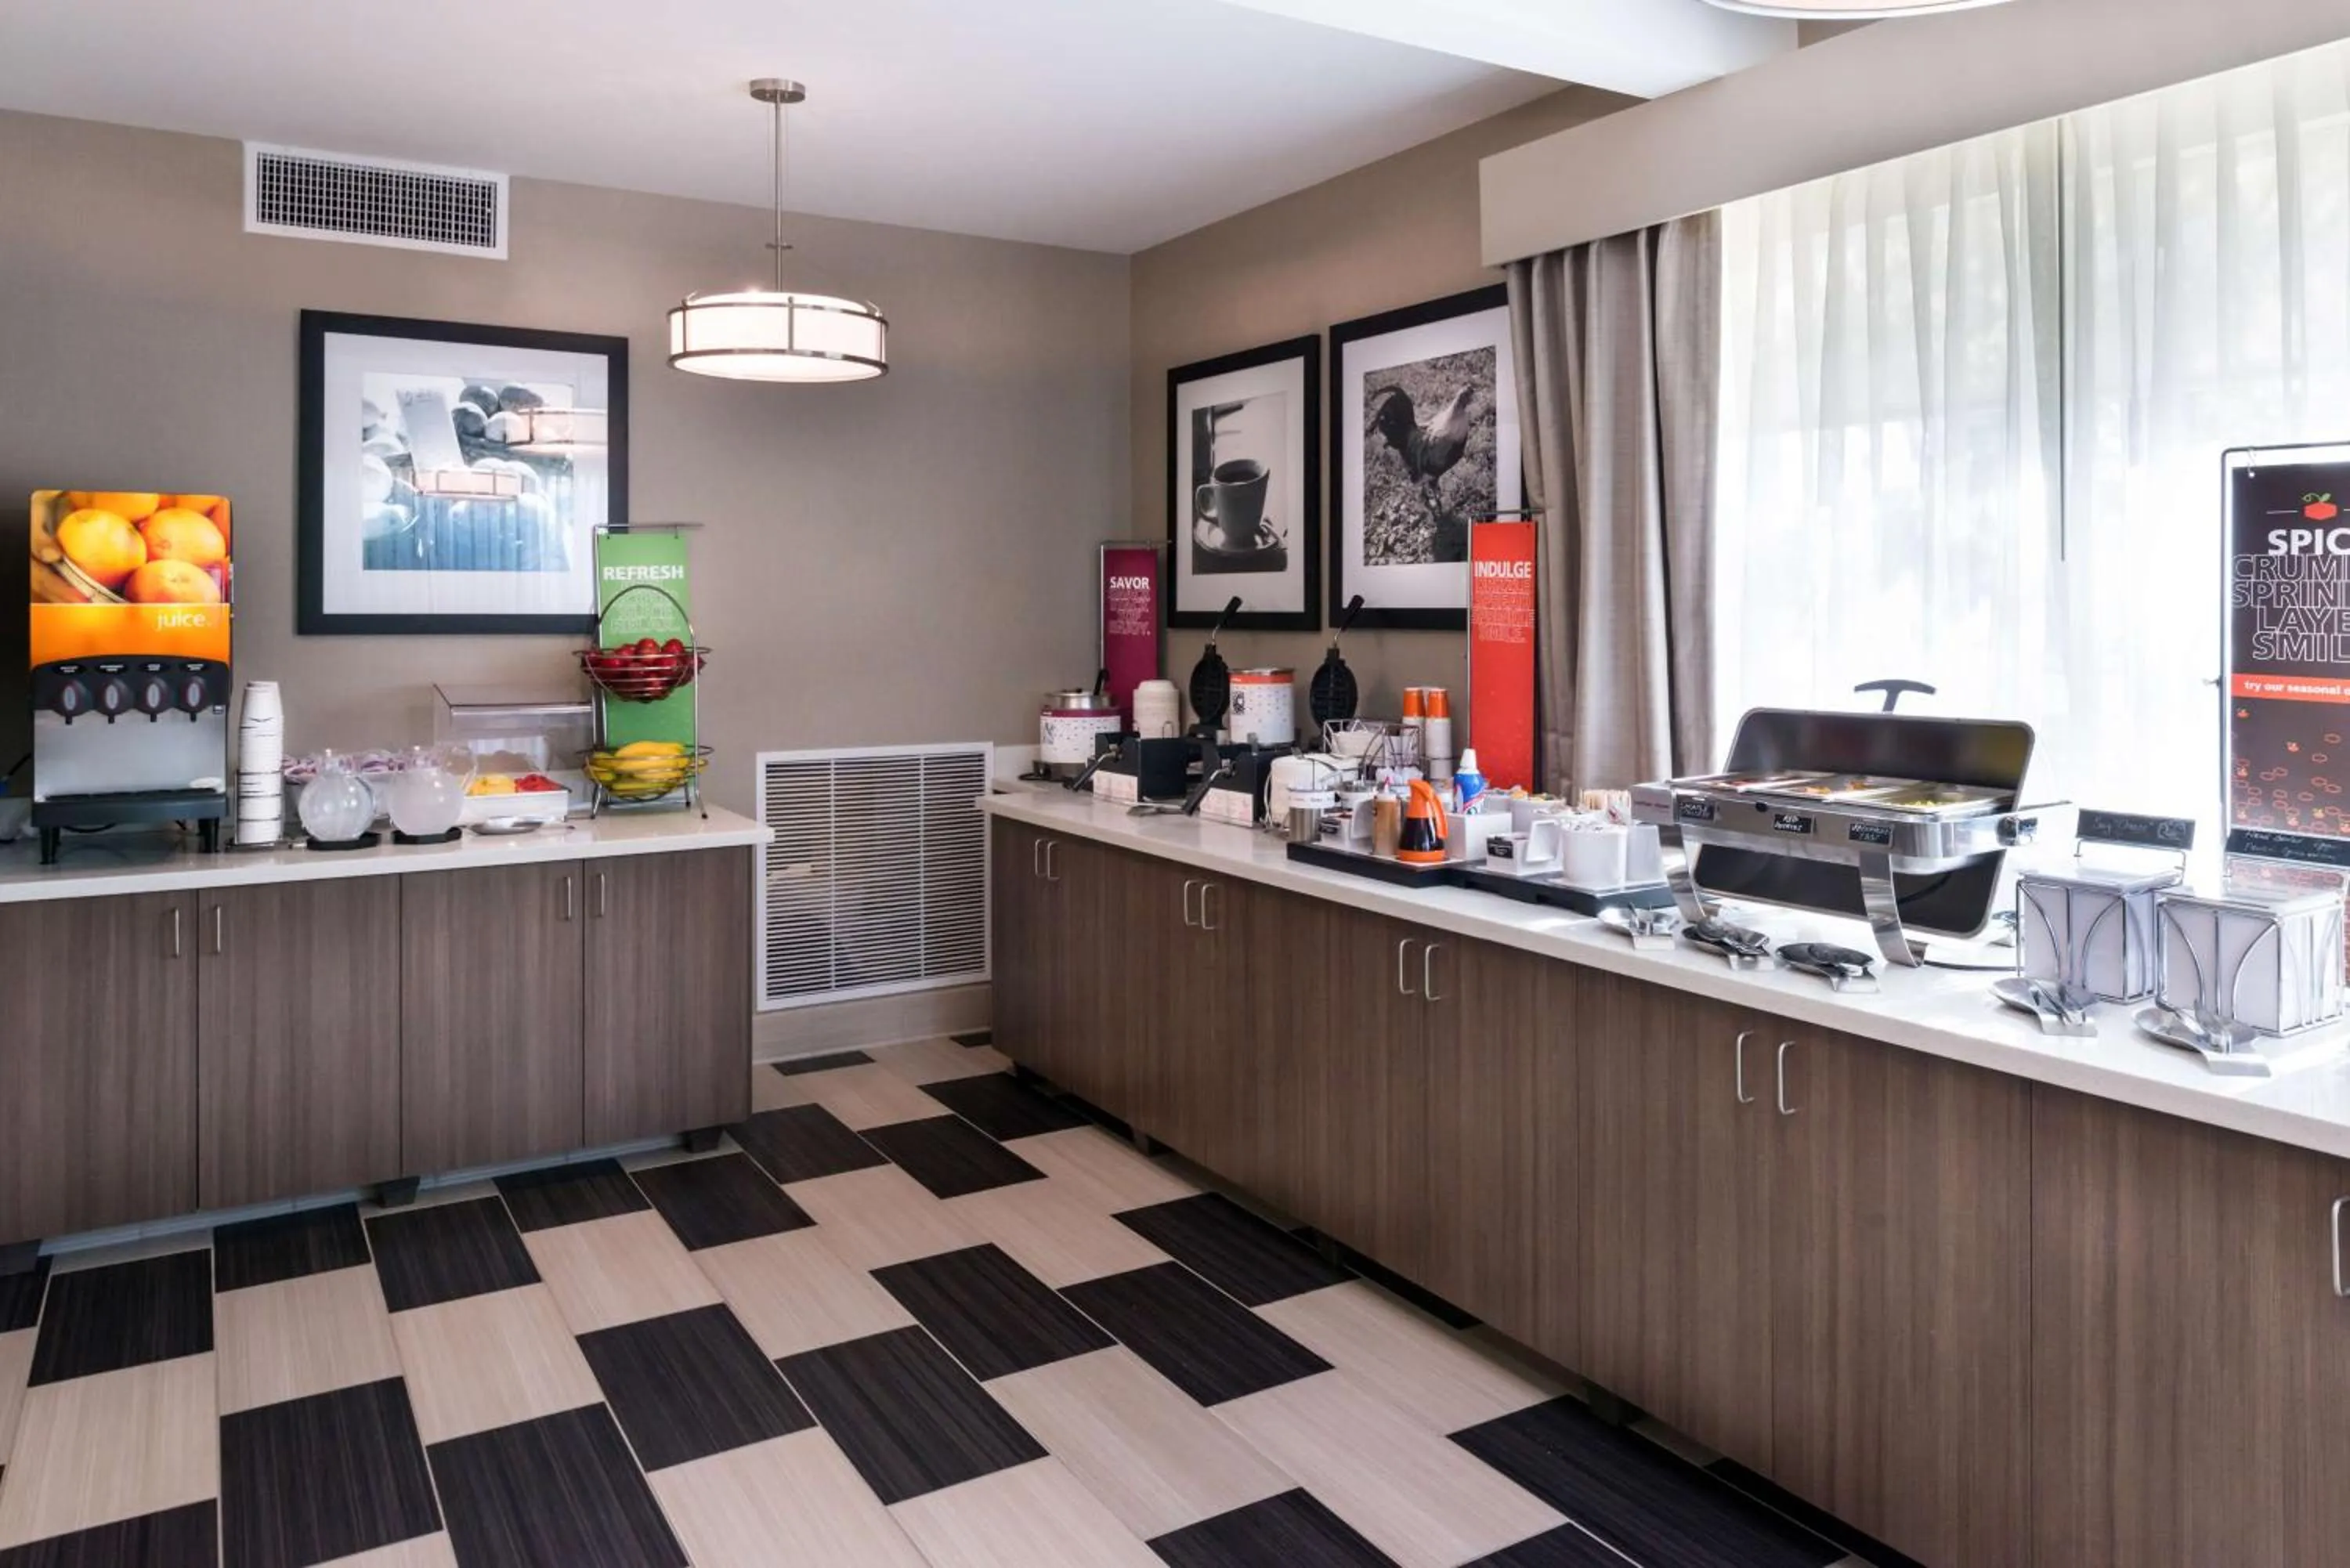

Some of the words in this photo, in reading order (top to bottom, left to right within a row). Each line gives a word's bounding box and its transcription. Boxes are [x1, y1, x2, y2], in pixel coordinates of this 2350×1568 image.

[602, 565, 684, 580] REFRESH
[1474, 560, 1532, 578] INDULGE
[2232, 554, 2350, 581] CRUM
[1109, 576, 1150, 590] SAVOR
[2232, 580, 2350, 609] SPRIN
[2243, 681, 2261, 692] try
[2263, 683, 2284, 692] our
[2287, 684, 2341, 696] seasonal
